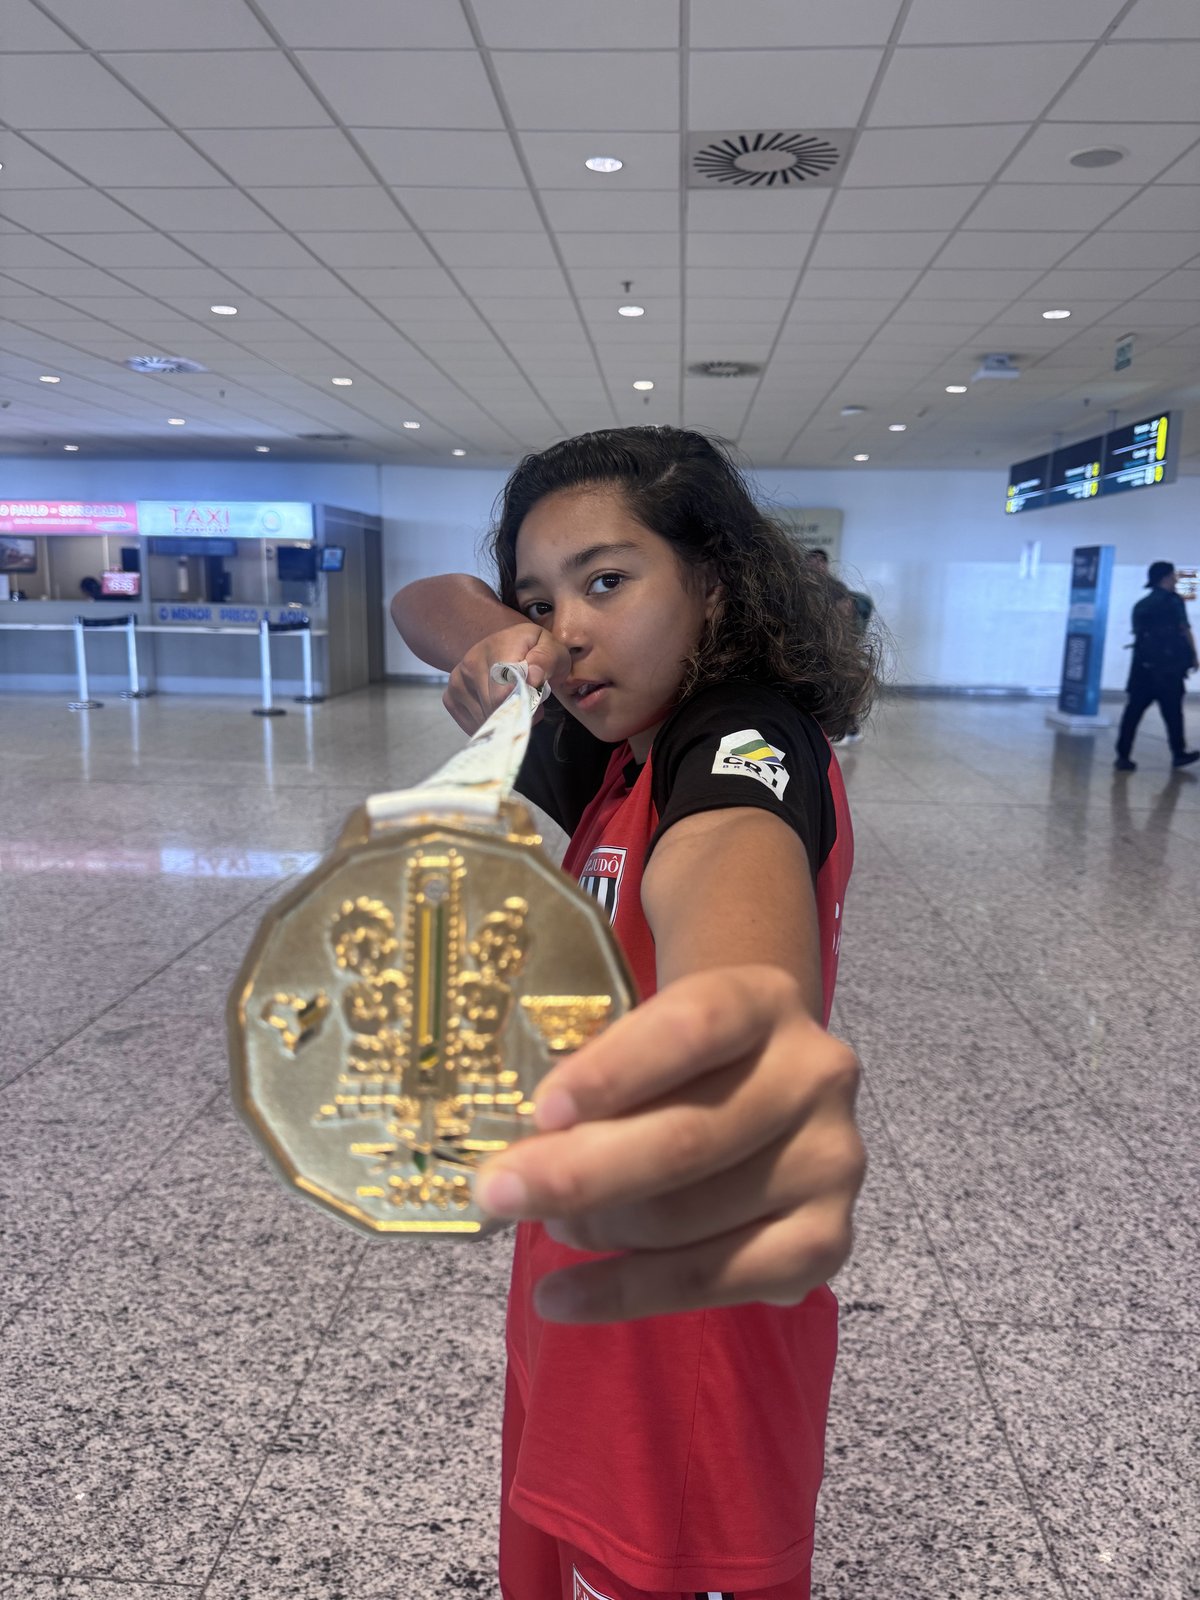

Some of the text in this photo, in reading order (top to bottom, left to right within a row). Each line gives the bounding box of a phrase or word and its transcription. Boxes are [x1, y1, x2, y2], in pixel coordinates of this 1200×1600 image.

[10, 504, 49, 517] PAULO
[168, 506, 231, 527] TAXI
[171, 606, 212, 621] MENOR
